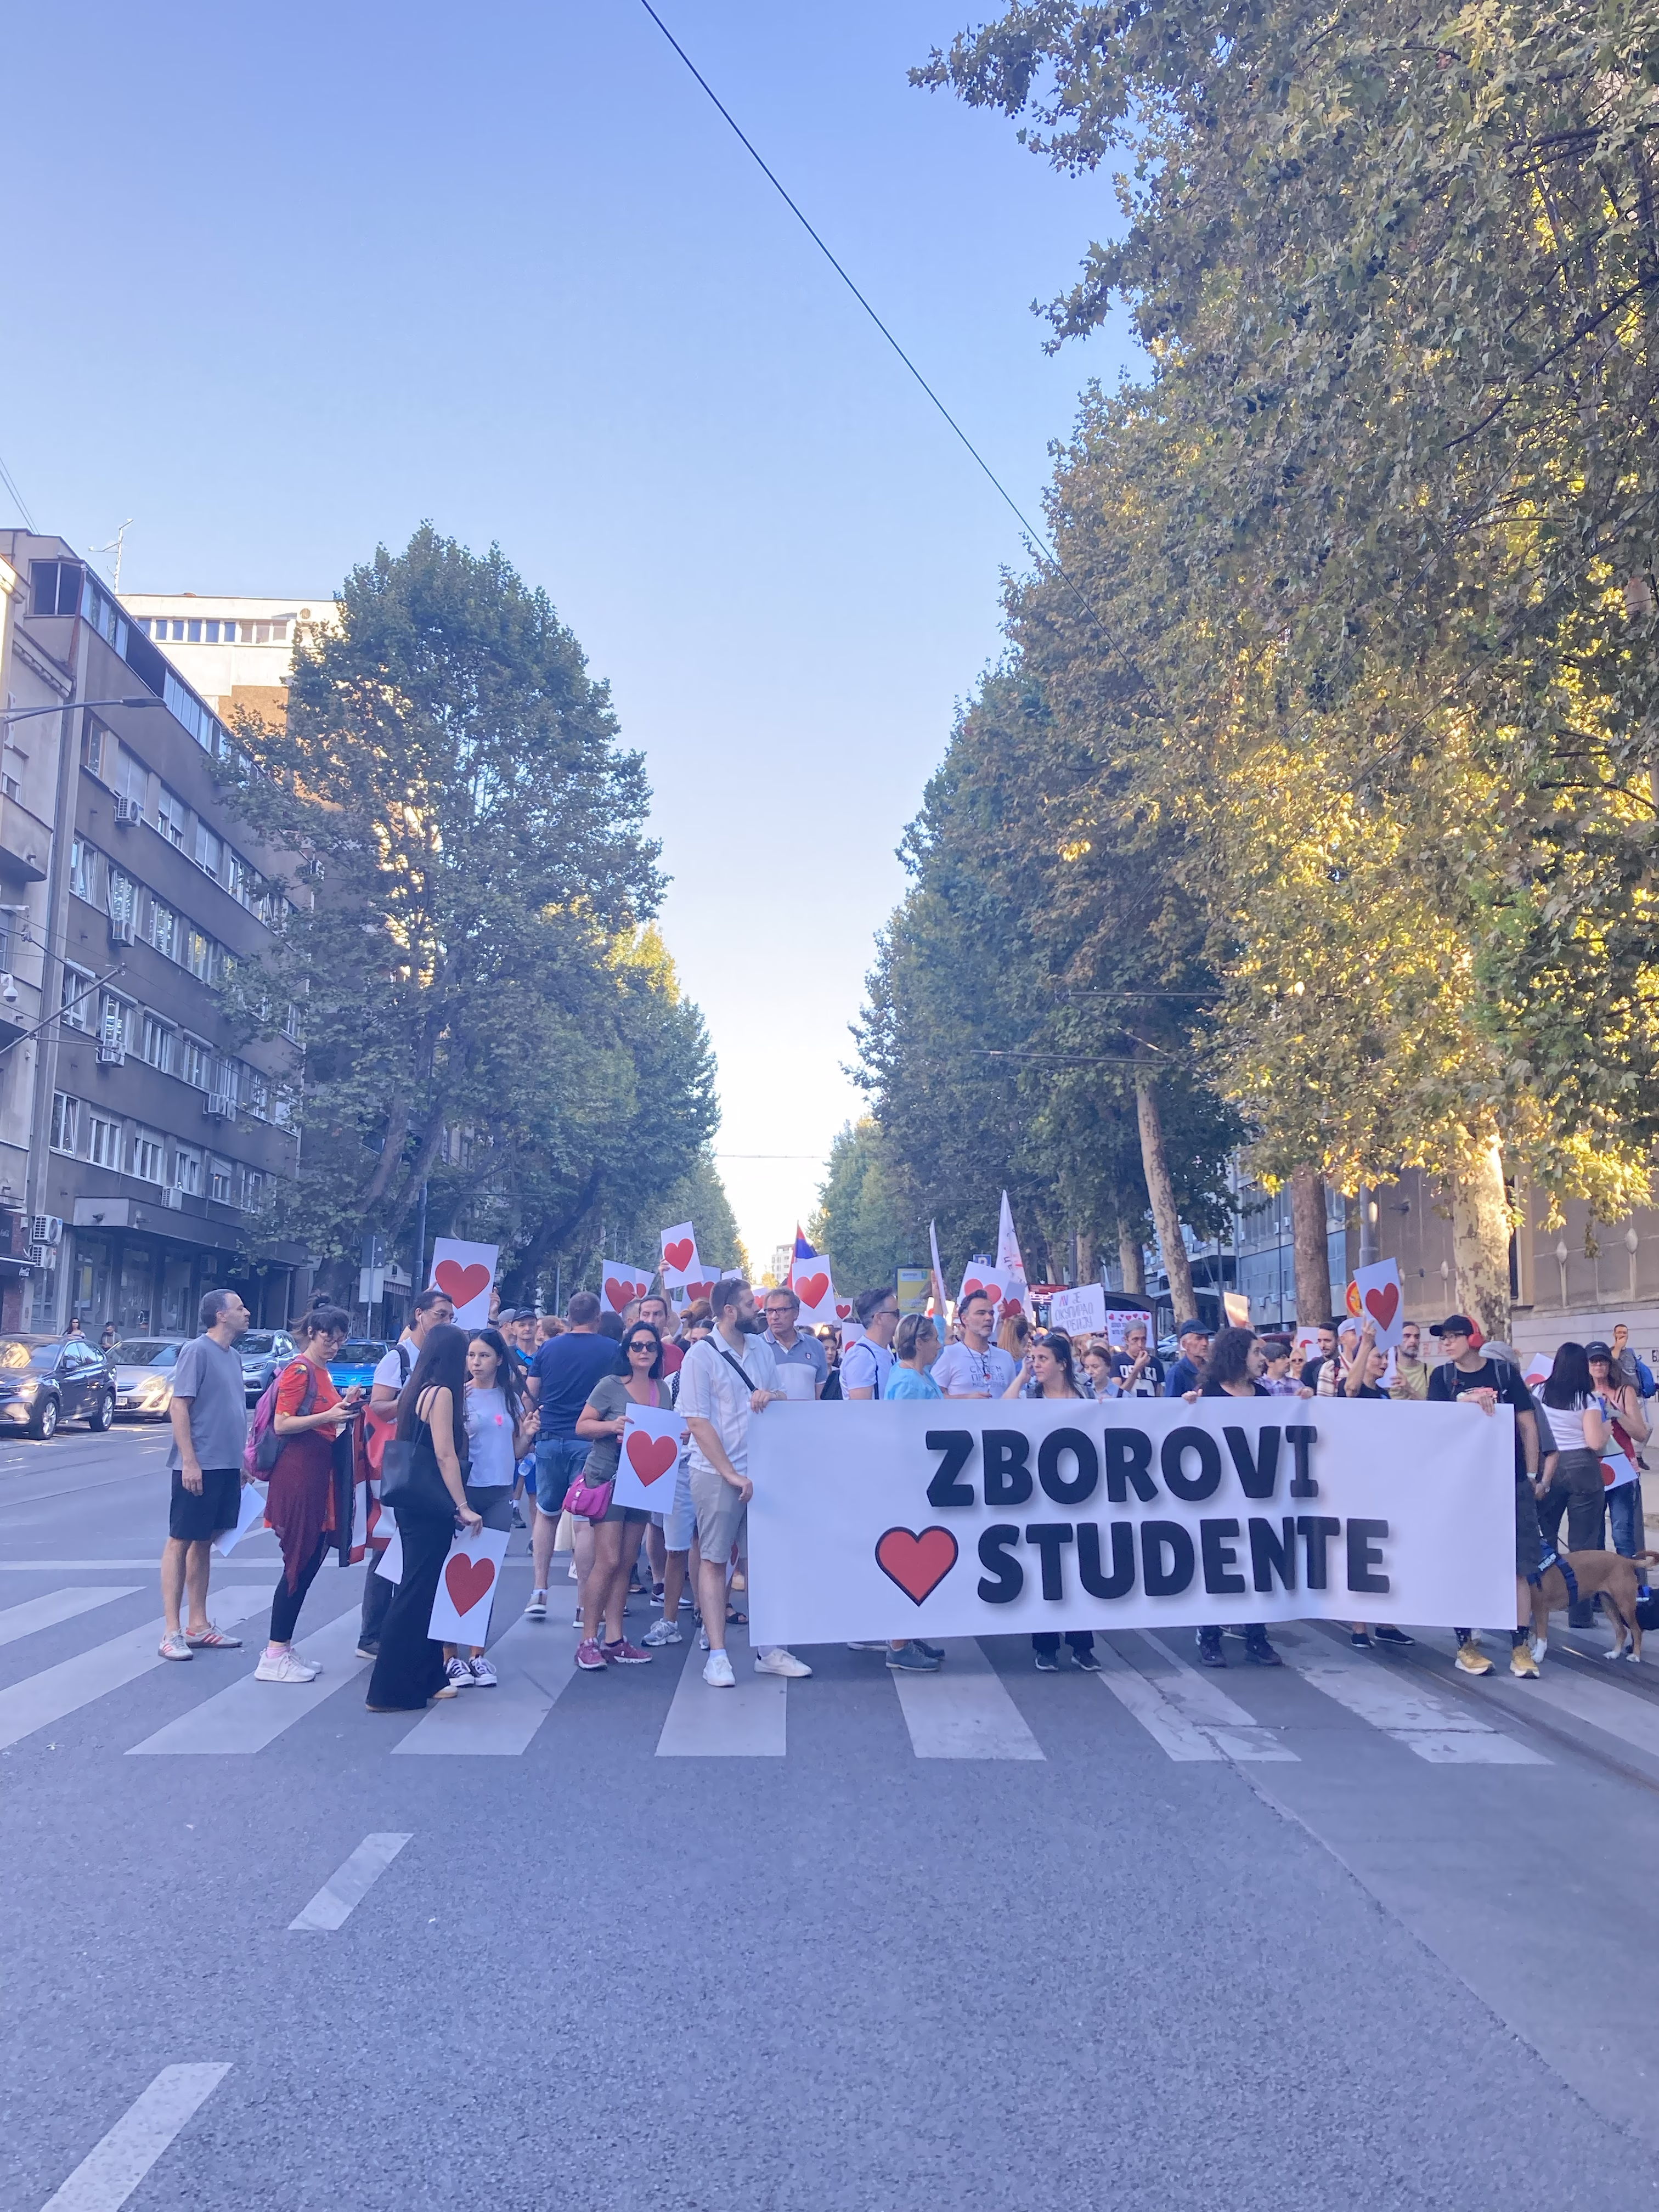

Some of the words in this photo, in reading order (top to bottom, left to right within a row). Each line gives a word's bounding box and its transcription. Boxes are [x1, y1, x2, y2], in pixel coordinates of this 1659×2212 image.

[1055, 1302, 1094, 1321] ОКУПИРАО
[971, 1373, 1005, 1381] ПРТИВ
[926, 1425, 1319, 1507] ZBOROVI
[977, 1516, 1390, 1604] STUDENTE
